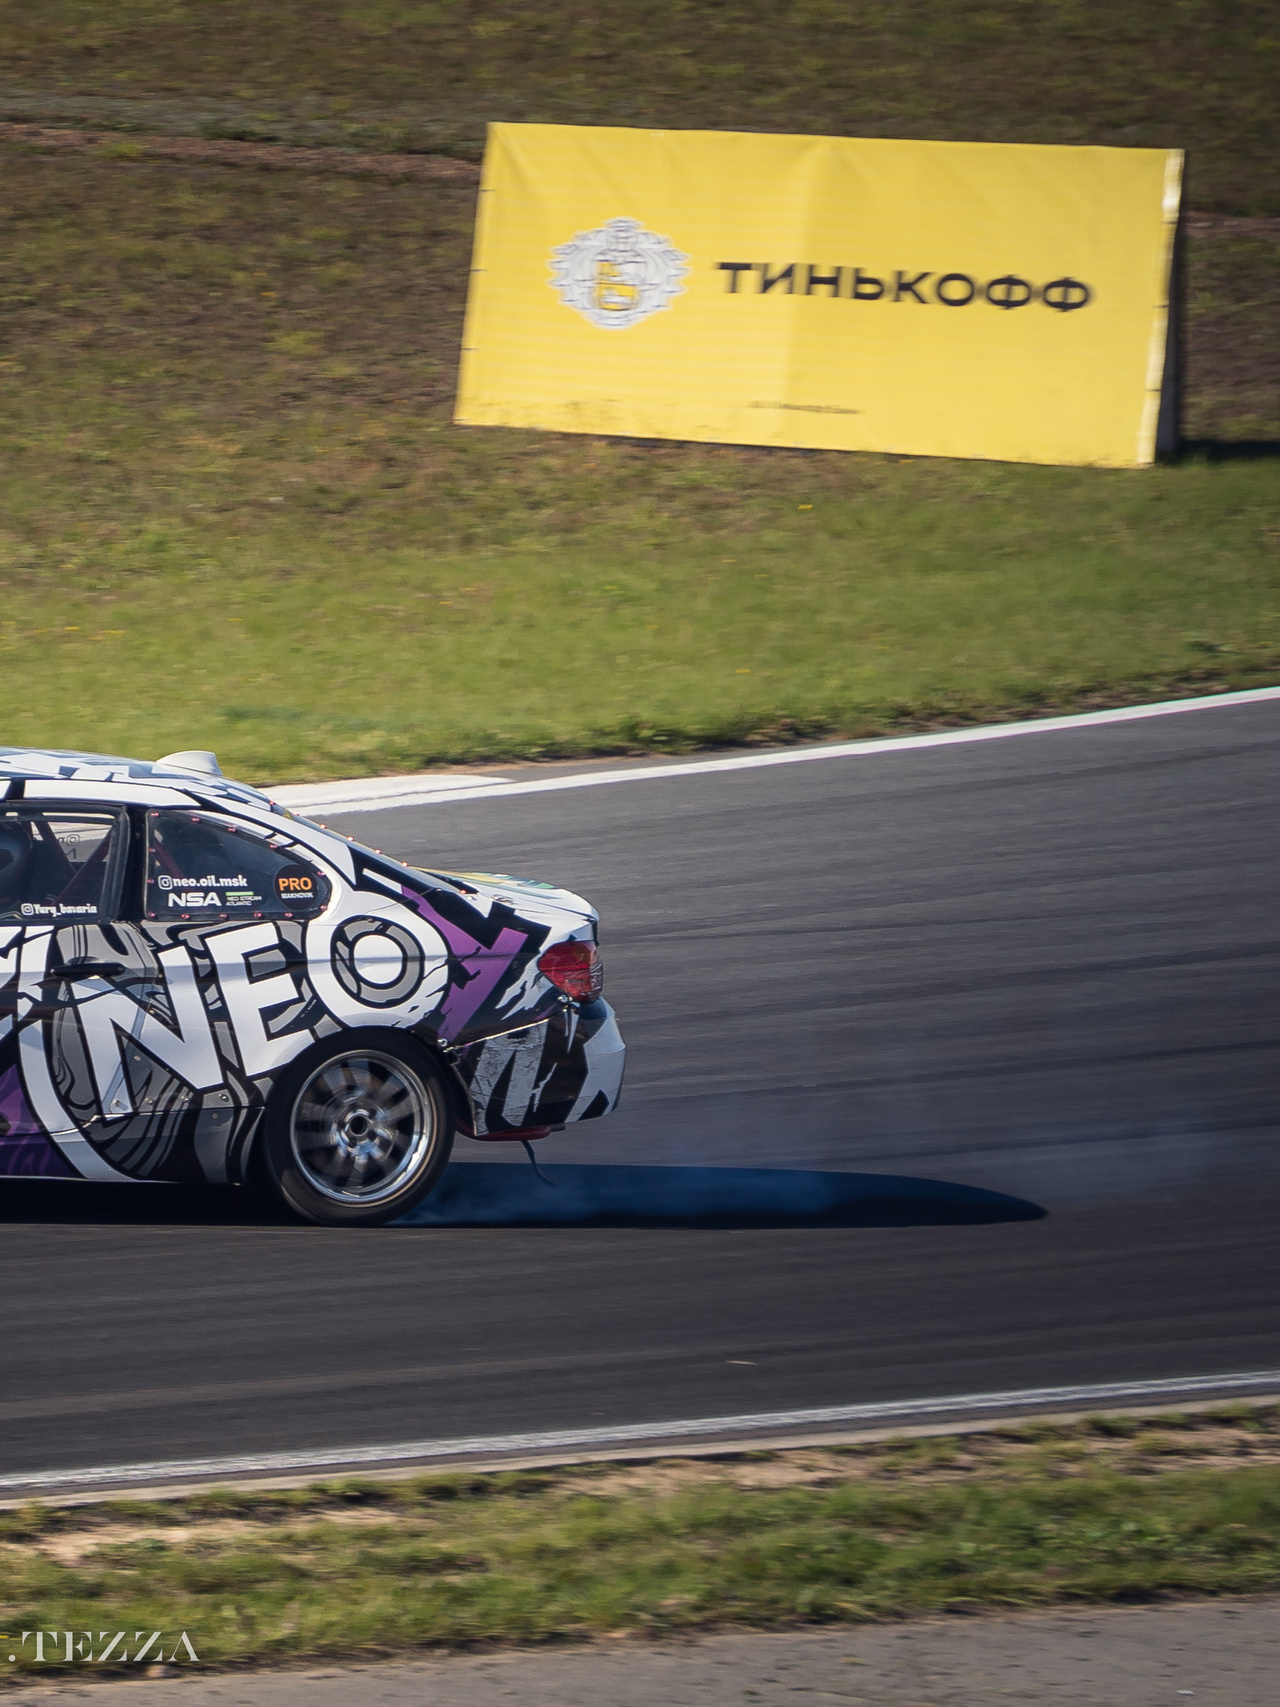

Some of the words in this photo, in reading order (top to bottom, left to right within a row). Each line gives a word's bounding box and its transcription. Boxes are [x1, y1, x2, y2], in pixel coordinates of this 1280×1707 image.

[716, 261, 1091, 313] ТИНЬКОФФ
[172, 874, 248, 887] neo.oil.msk
[278, 877, 313, 891] PRO
[168, 892, 222, 907] NSA
[69, 890, 451, 1115] NEO
